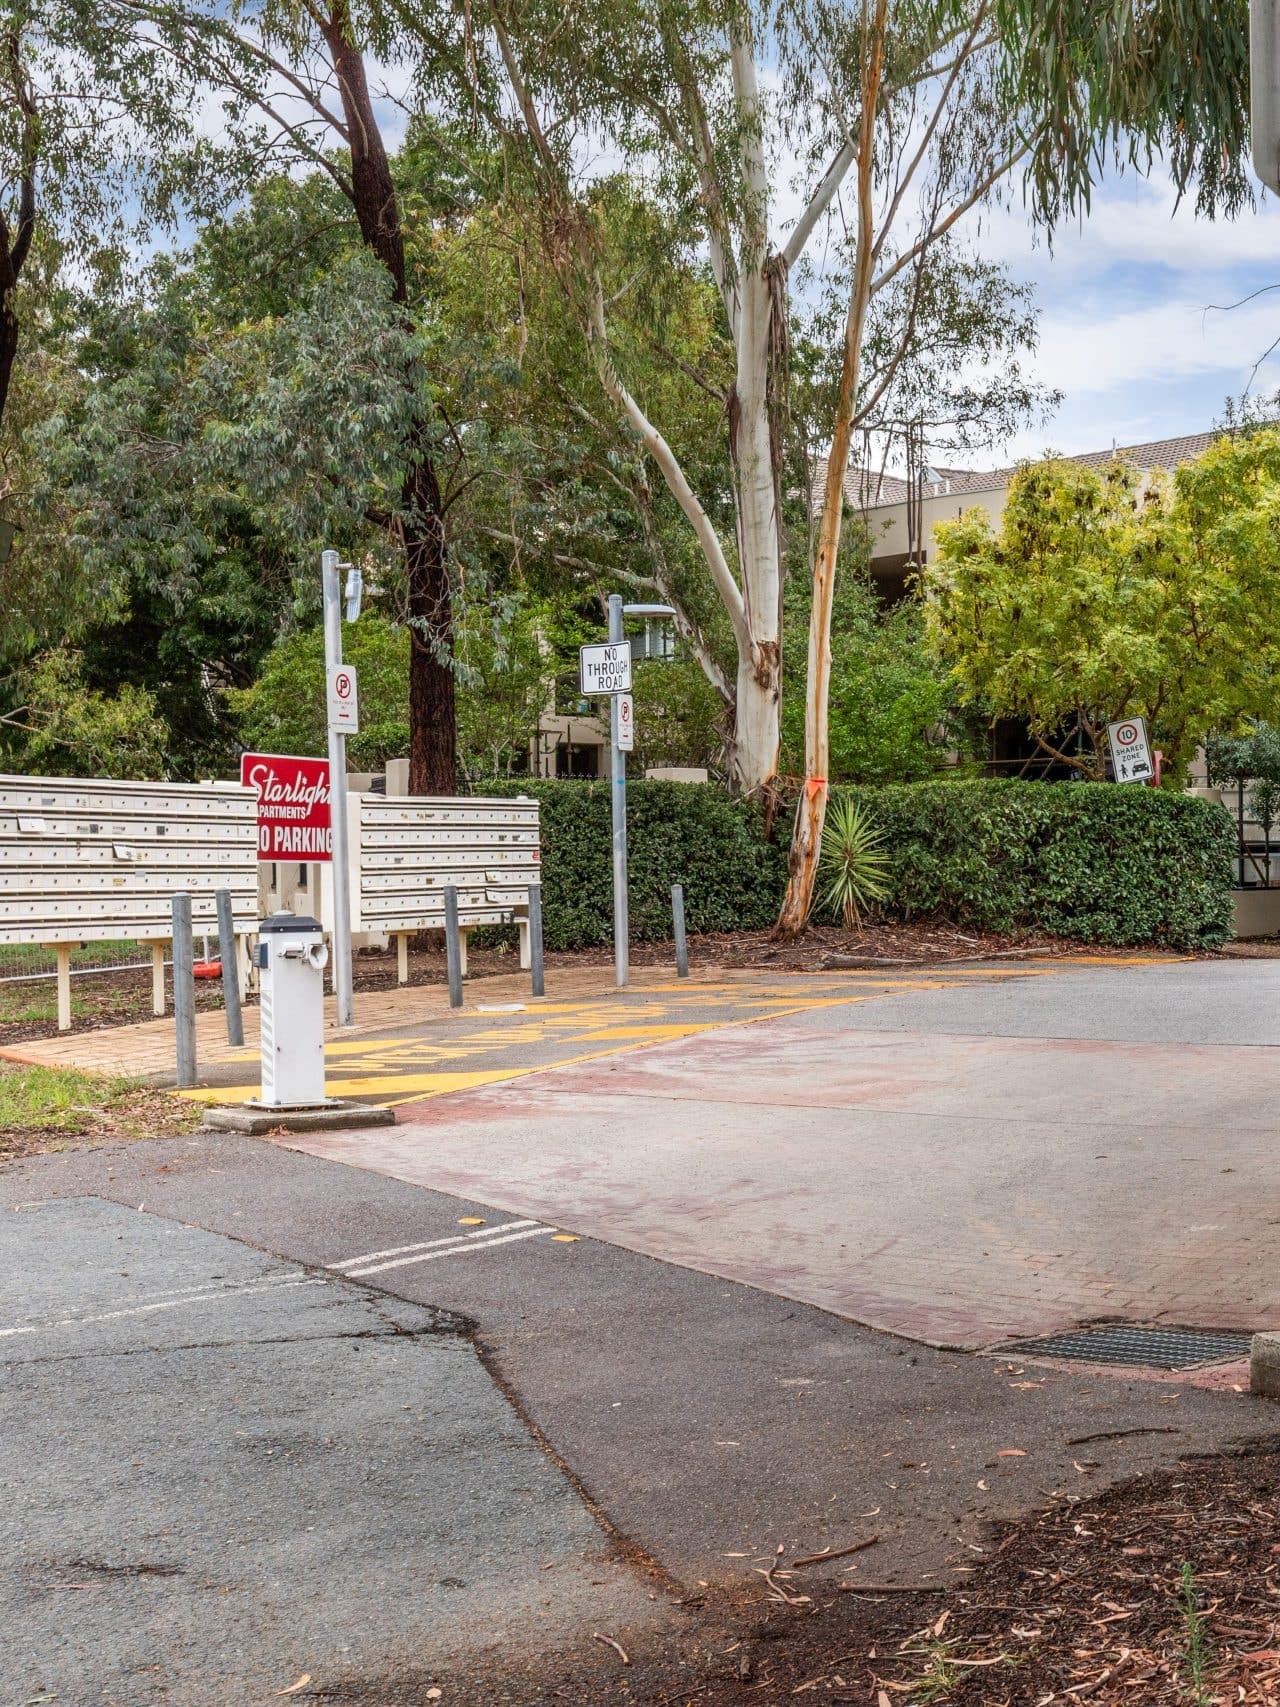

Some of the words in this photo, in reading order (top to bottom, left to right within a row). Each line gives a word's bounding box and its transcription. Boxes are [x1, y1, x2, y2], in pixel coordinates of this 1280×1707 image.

[604, 648, 617, 661] NO
[587, 660, 628, 677] THROUGH
[598, 675, 623, 690] ROAD
[1121, 729, 1133, 740] 10
[1116, 744, 1144, 755] SHARED
[1122, 752, 1141, 762] ZONE
[257, 825, 270, 853] O
[274, 825, 332, 853] PARKING
